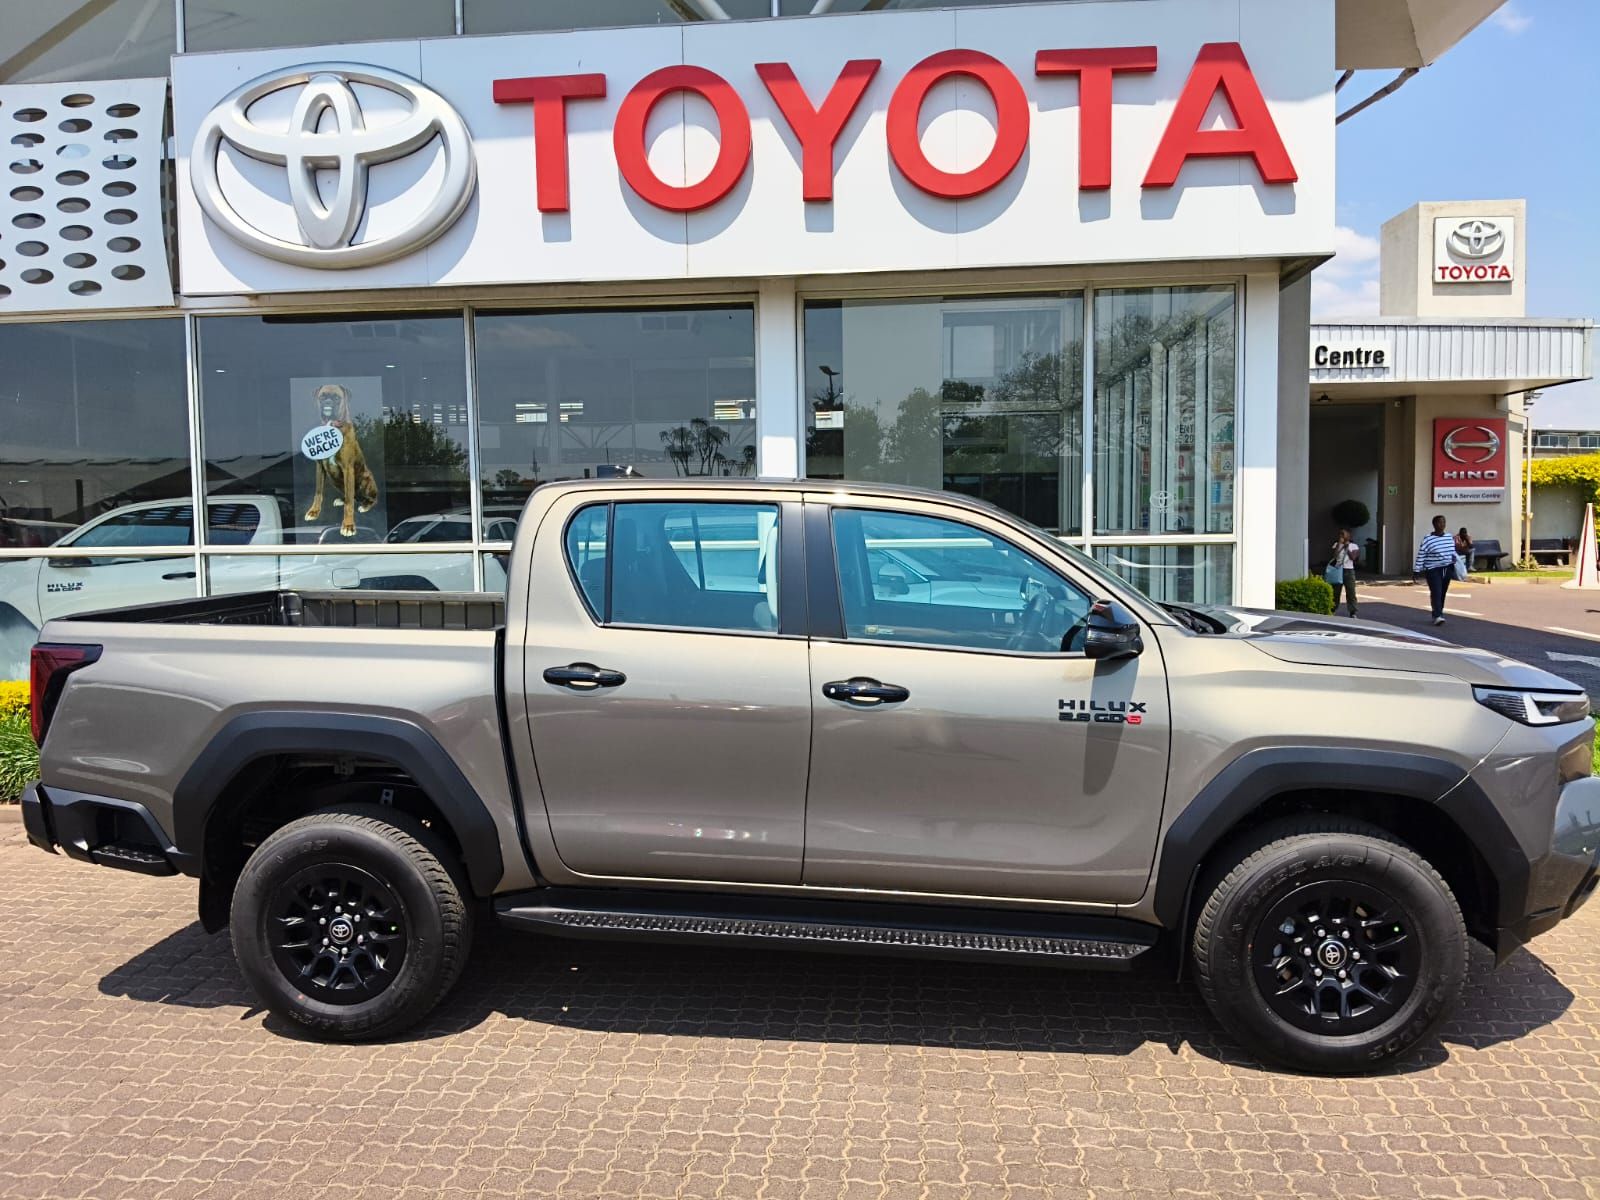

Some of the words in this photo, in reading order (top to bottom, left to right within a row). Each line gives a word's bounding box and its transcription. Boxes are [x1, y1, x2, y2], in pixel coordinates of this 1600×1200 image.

[493, 42, 1299, 213] TOYOTA
[1438, 265, 1511, 280] TOYOTA
[1314, 345, 1385, 367] Centre
[304, 428, 338, 449] WE'RE
[308, 439, 340, 457] BACK!
[1443, 470, 1498, 480] HINO
[1058, 699, 1147, 713] HILUX
